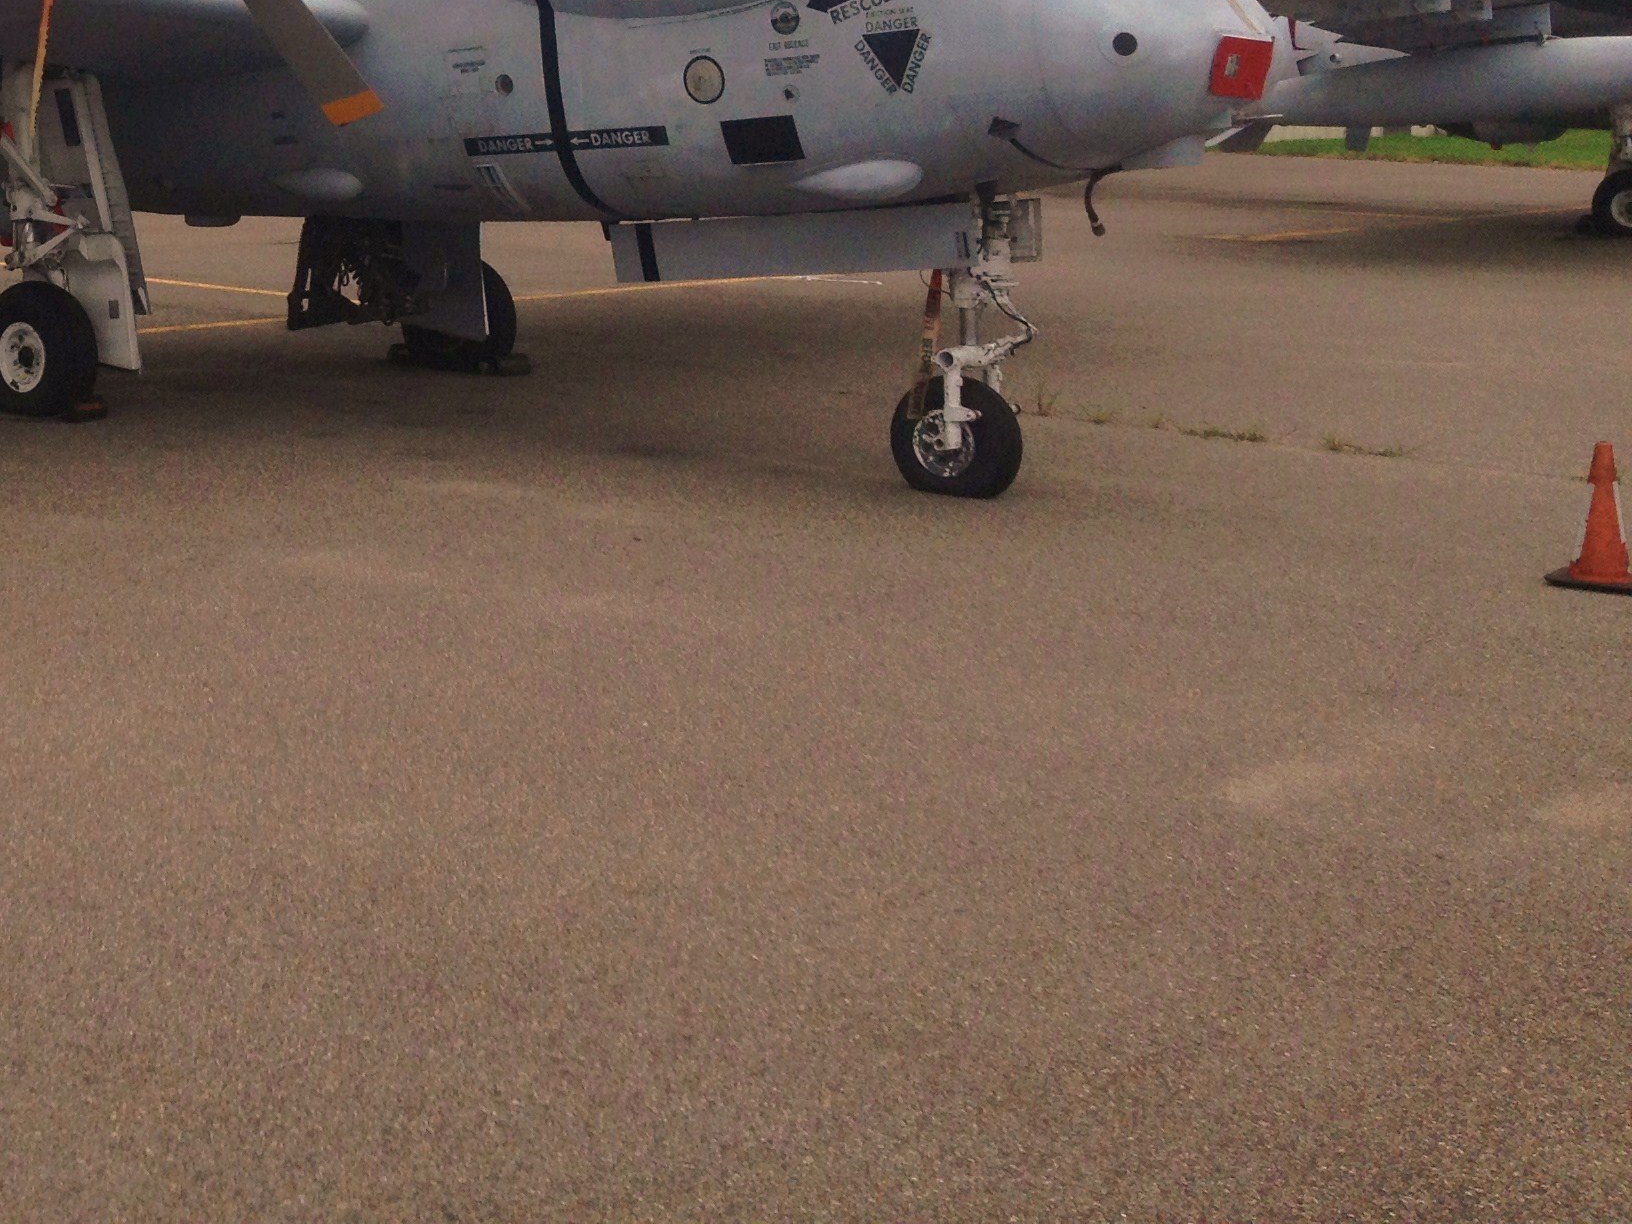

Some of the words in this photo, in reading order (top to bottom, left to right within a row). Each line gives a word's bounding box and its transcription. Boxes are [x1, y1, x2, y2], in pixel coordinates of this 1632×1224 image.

[865, 16, 918, 33] DANGER
[854, 39, 897, 96] DANGER
[901, 32, 932, 95] DANGER
[477, 137, 535, 153] DANGER
[590, 130, 652, 146] DANGER
